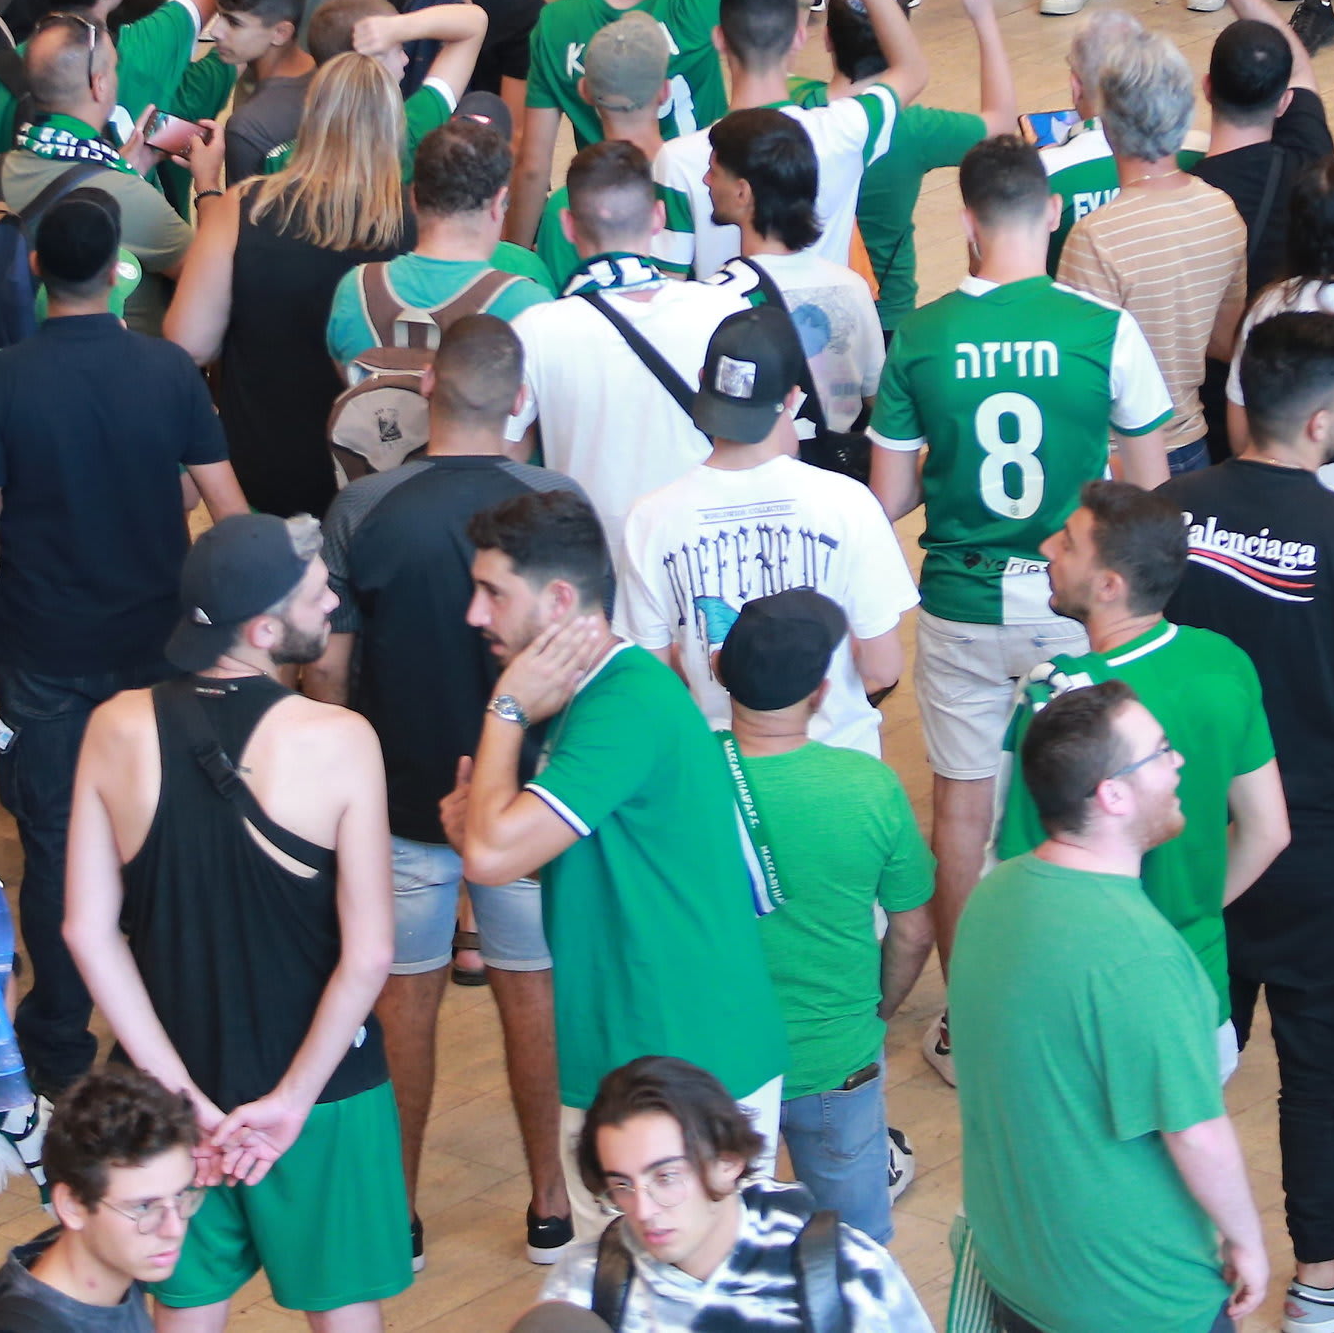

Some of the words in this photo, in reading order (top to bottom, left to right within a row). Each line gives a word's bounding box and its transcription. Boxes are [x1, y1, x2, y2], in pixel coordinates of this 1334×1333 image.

[954, 340, 1059, 380] חזיזה
[974, 391, 1045, 520] 8
[983, 557, 1050, 575] varie
